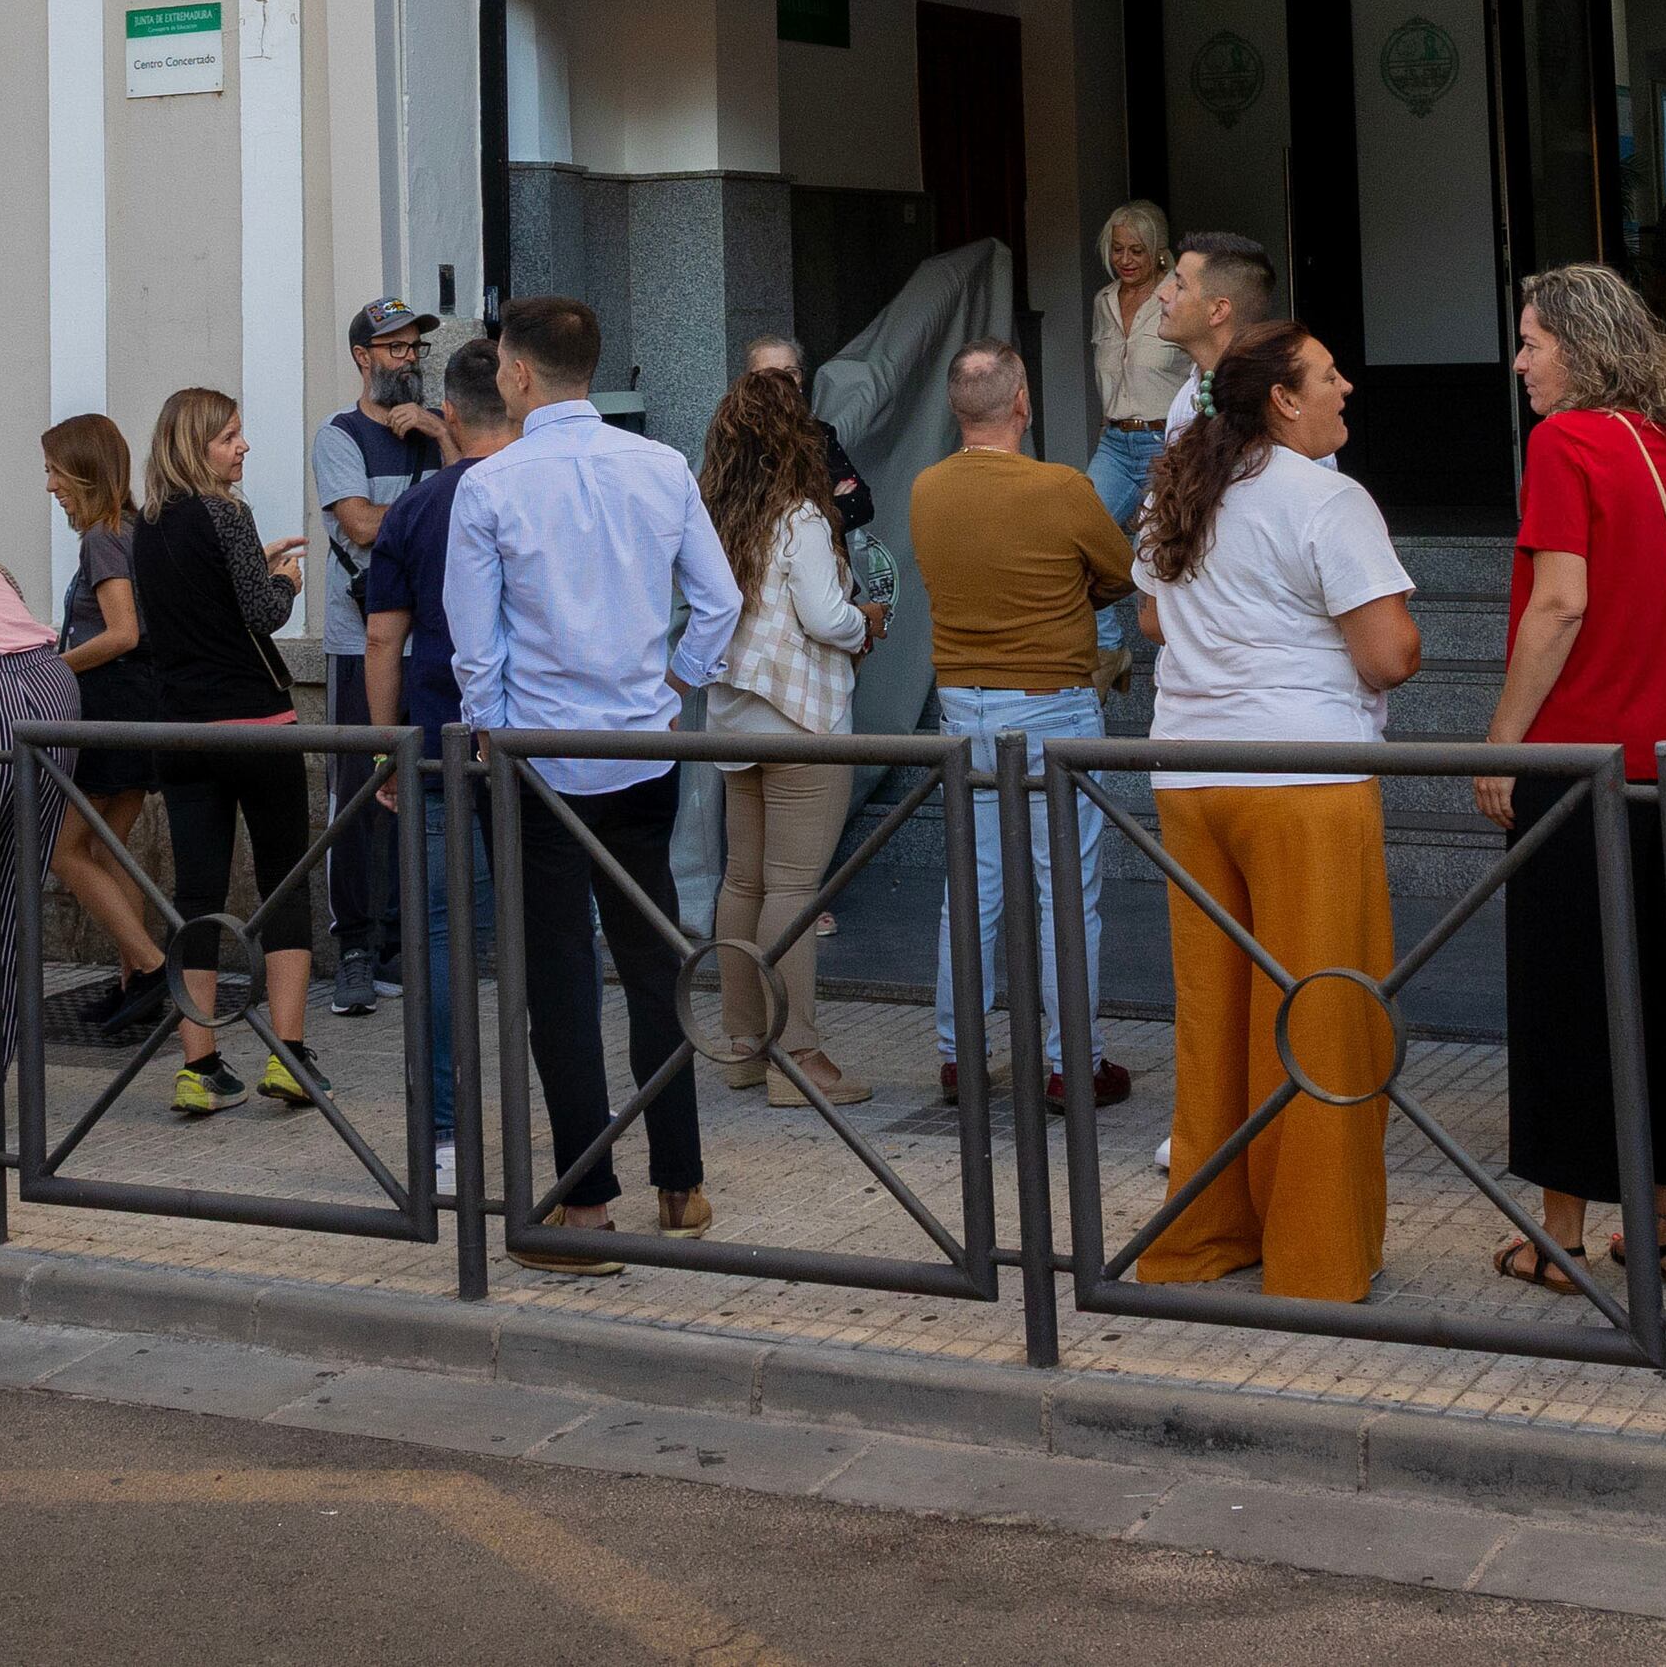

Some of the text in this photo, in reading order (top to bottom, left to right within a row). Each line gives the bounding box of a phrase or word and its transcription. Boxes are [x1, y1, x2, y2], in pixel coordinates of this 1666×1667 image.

[134, 10, 212, 27] JUNTA DE EXTREMADURA
[134, 54, 216, 70] Centro Concertado
